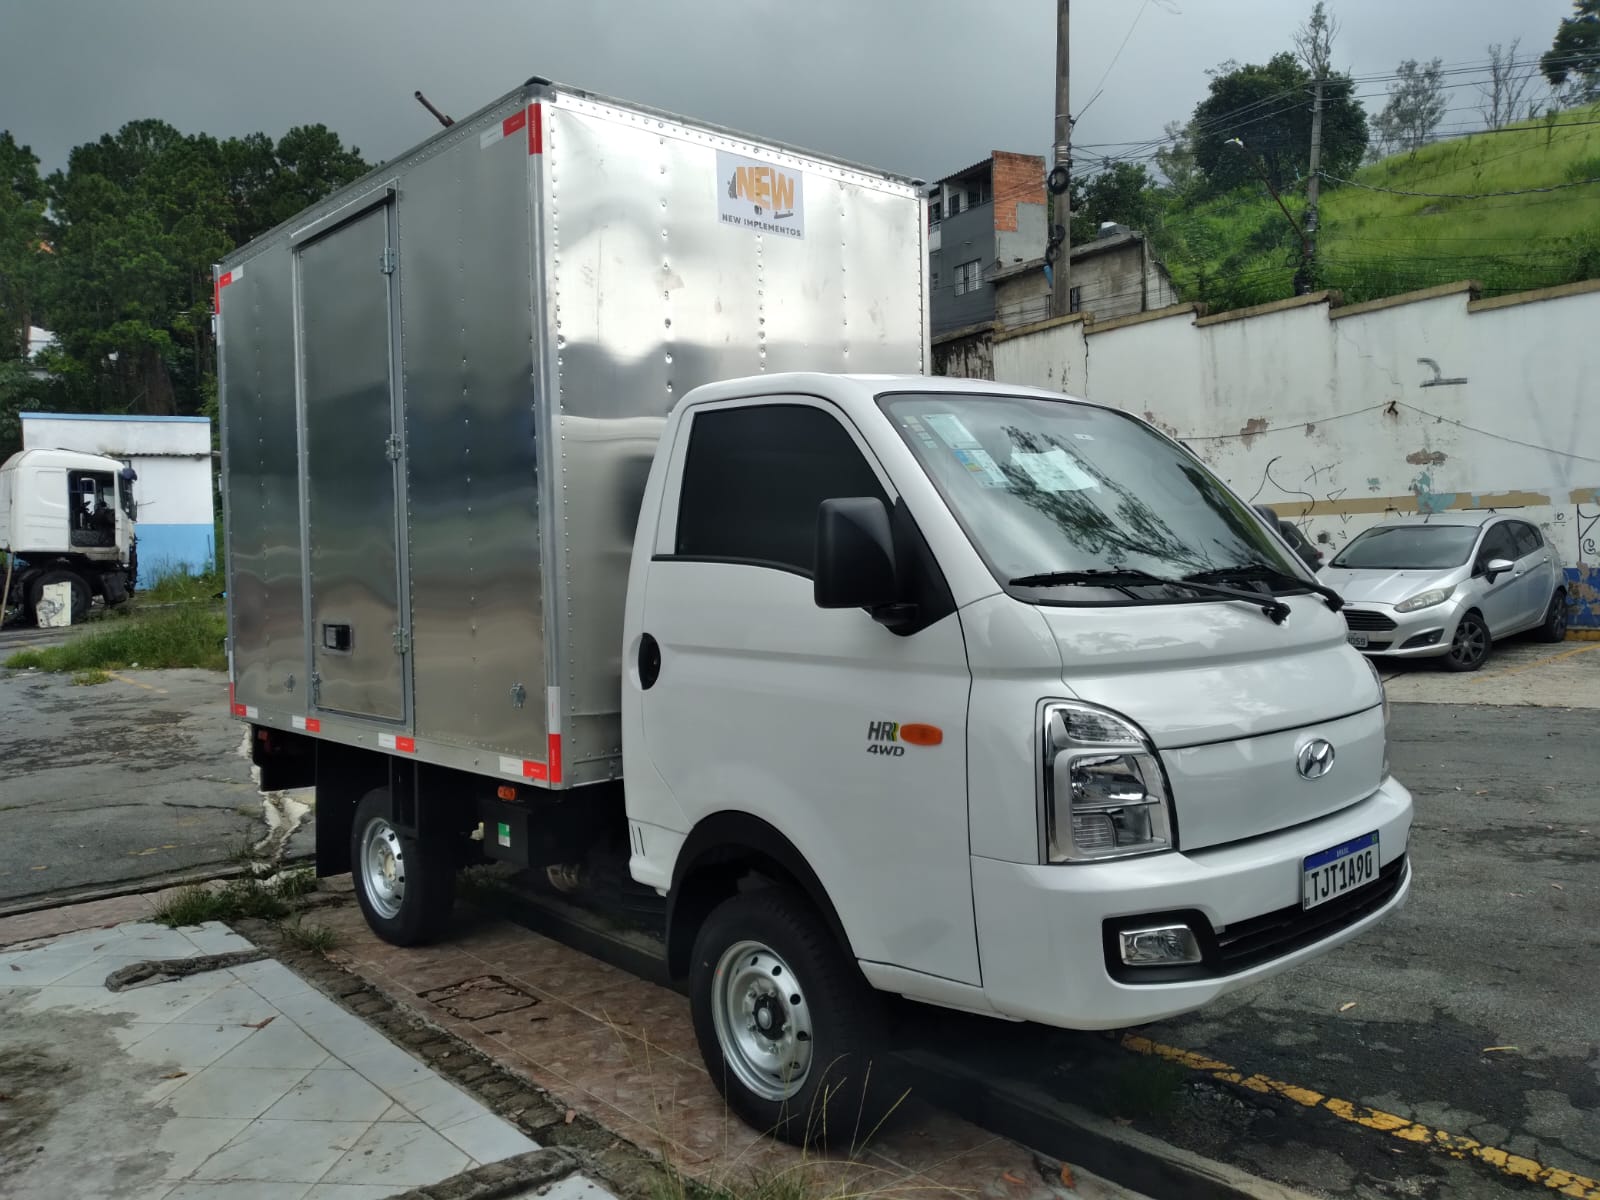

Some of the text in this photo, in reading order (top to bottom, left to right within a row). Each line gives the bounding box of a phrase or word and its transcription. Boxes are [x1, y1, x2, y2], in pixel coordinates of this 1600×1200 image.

[736, 166, 794, 210] NEW
[722, 213, 801, 237] NEW IMPLEMENTOS
[868, 721, 897, 741] HR
[867, 744, 905, 757] 4WD
